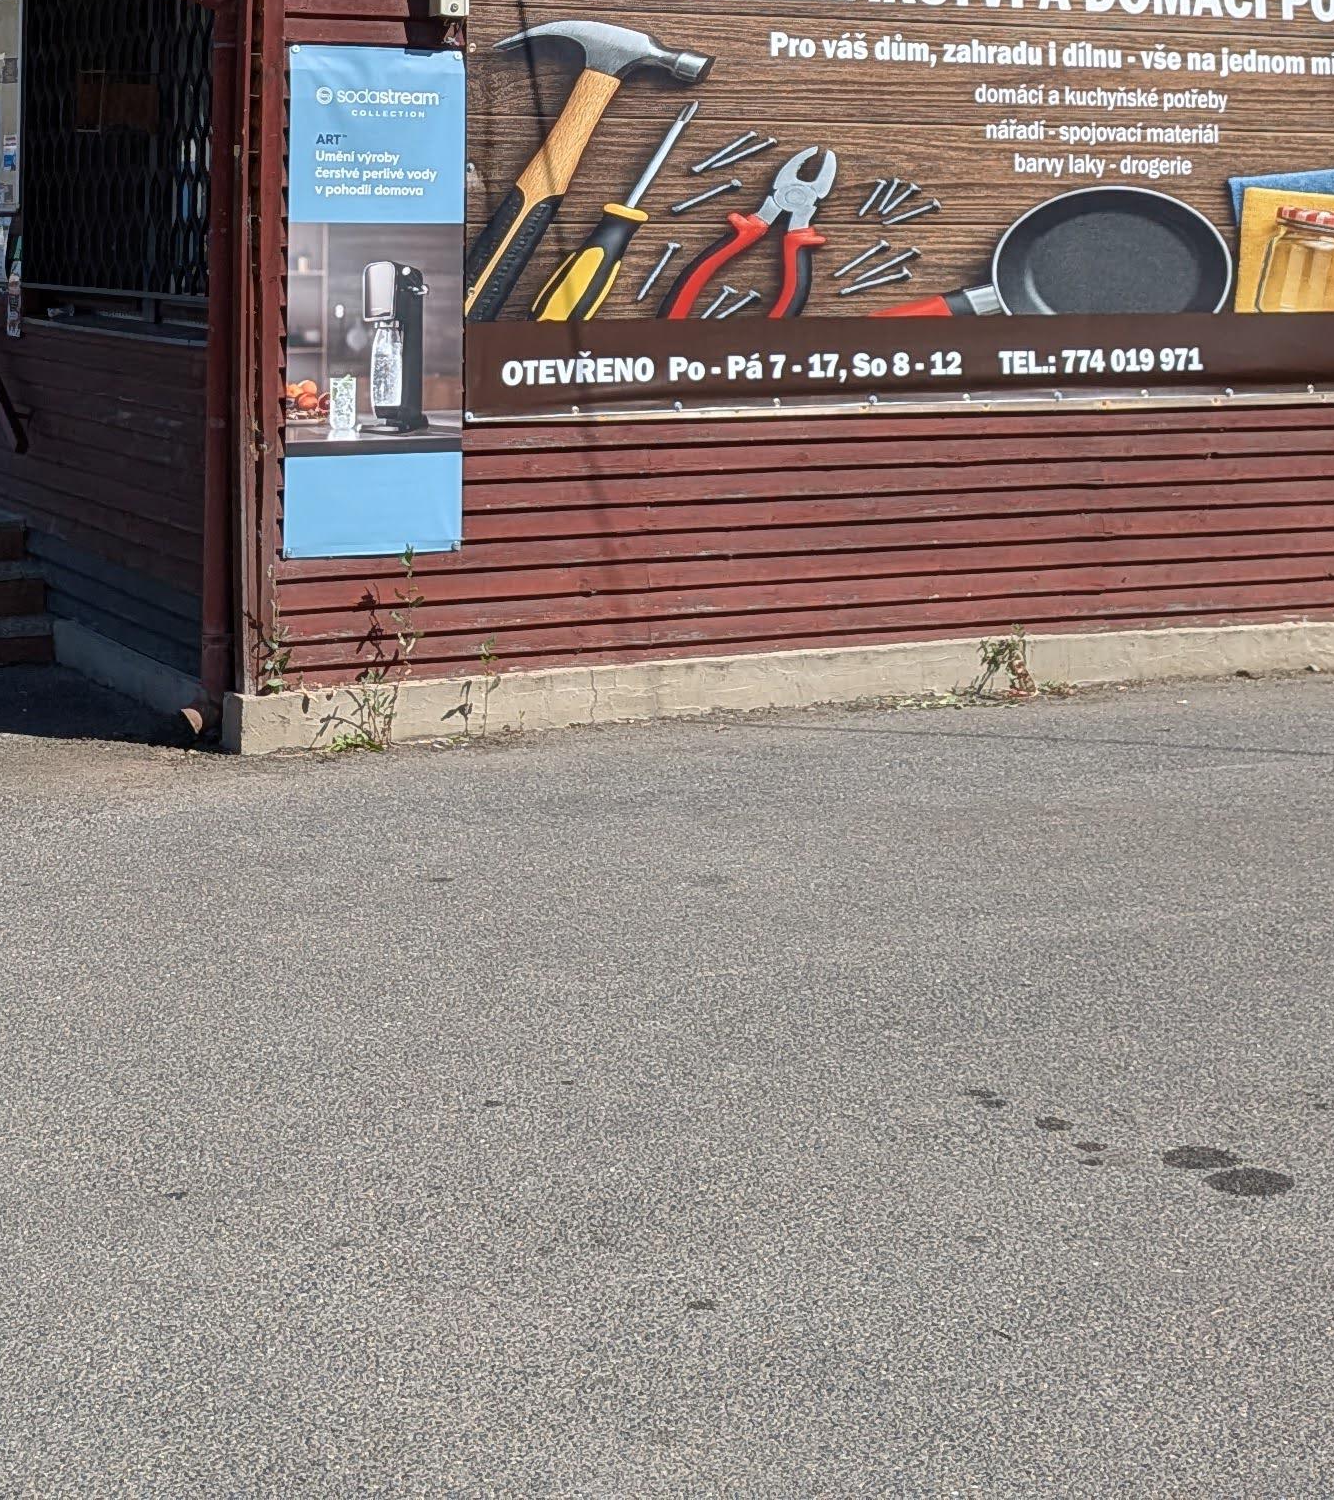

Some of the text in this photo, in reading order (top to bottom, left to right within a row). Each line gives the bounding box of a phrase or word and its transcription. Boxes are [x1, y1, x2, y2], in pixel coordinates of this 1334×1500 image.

[770, 31, 816, 58] Pro
[822, 32, 868, 60] váš
[875, 34, 937, 68] dům,
[943, 39, 1043, 66] zahradu
[1048, 41, 1057, 67] i
[1063, 41, 1122, 69] dílnu
[1141, 44, 1182, 71] vše
[1187, 52, 1216, 72] na
[1220, 47, 1305, 77] jednom
[337, 88, 440, 106] sodastream
[975, 83, 1228, 113] domácí a kuchyňské potřeby
[351, 109, 425, 118] COLLECTION
[986, 118, 1044, 140] nářadí
[1059, 122, 1143, 146] spojovací
[1146, 124, 1219, 144] materiál
[315, 150, 400, 166] Umění výroby
[1014, 152, 1064, 178] barvy
[1069, 153, 1106, 178] laky
[1120, 155, 1193, 179] drogerie
[315, 166, 438, 183] čerstvé perlivé vody
[315, 183, 424, 198] v pohodlí domova
[501, 350, 655, 386] OTEVŘENO
[669, 356, 706, 382] Po
[727, 352, 763, 380] Pá
[769, 354, 787, 379] 7
[808, 353, 847, 384] 17,
[852, 352, 888, 377] So
[892, 352, 910, 377] 8
[930, 351, 963, 376] 12
[998, 350, 1056, 375] TEL.:
[1062, 349, 1106, 374] 774
[1110, 348, 1155, 373] 019
[1159, 347, 1204, 372] 971
